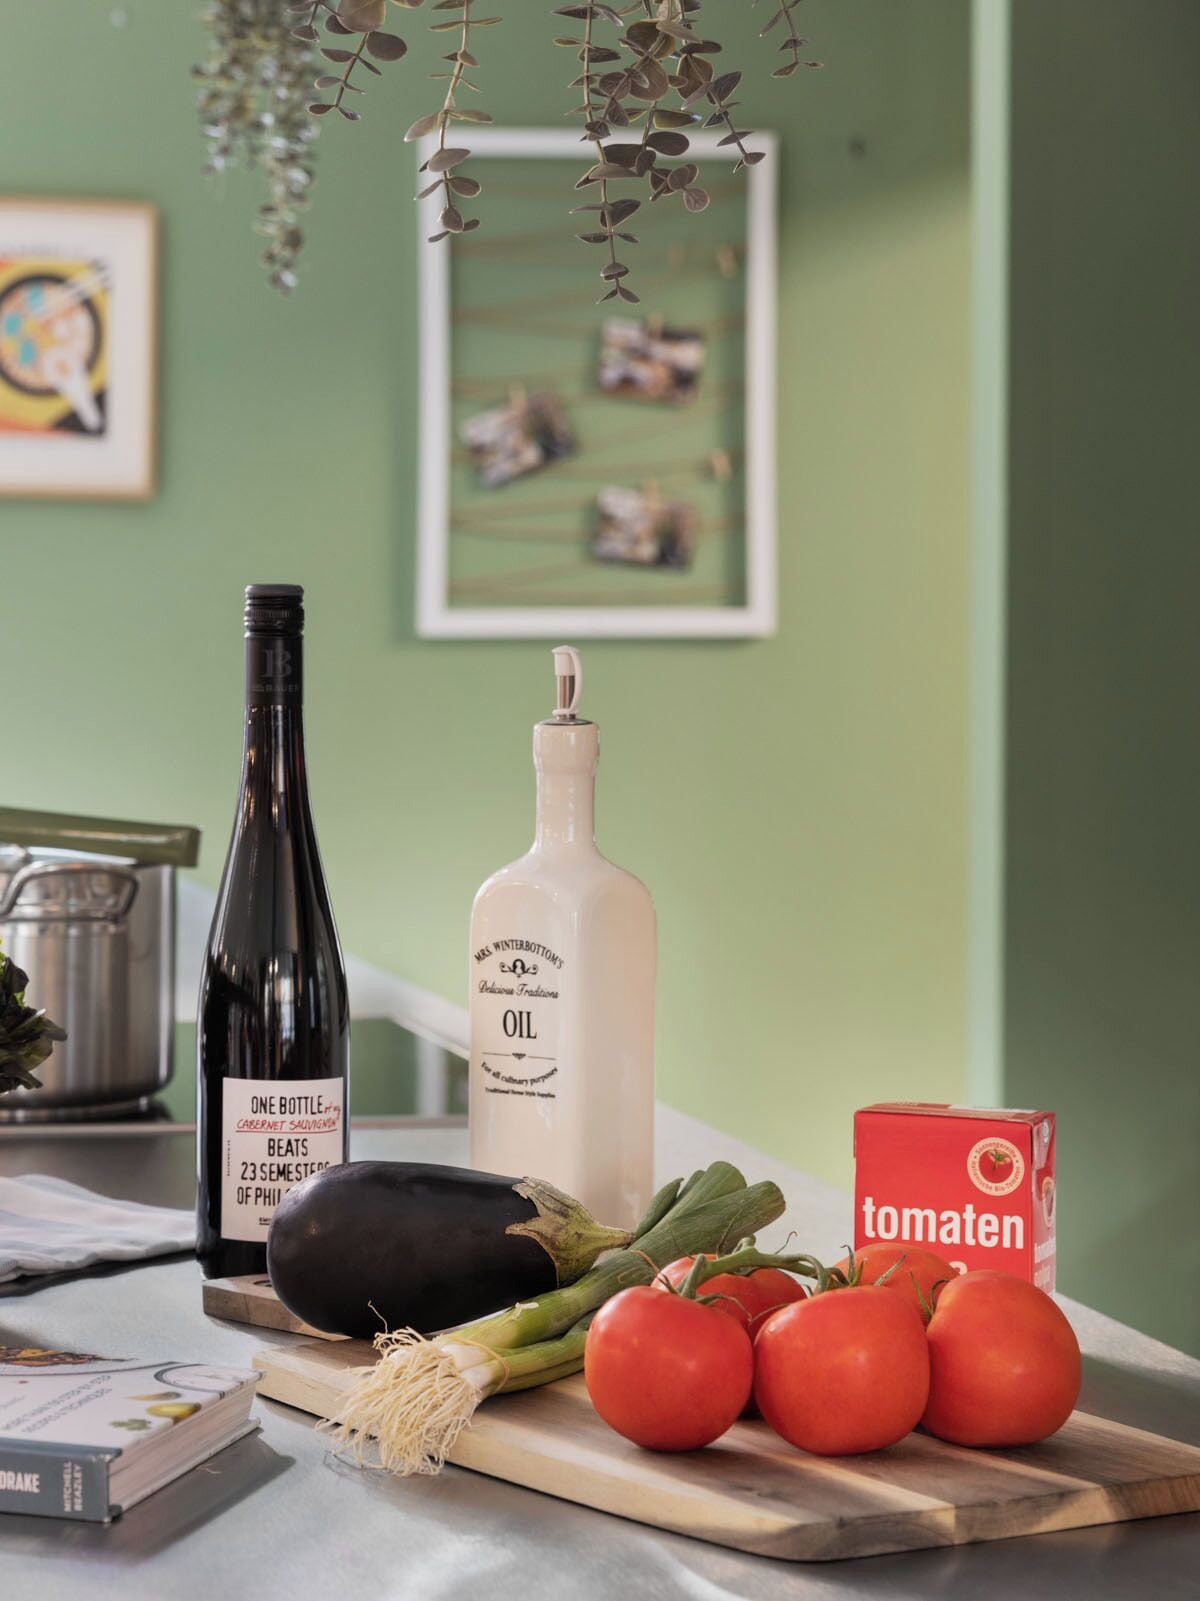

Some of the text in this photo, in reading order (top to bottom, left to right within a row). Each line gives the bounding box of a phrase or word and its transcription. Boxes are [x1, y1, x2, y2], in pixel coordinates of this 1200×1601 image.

[492, 939, 565, 970] WINTERBOTTOM'S
[478, 980, 559, 999] Delicious Traditions
[503, 1009, 537, 1039] OIL
[251, 1096, 276, 1115] ONE
[279, 1095, 324, 1115] BOTTLE
[236, 1117, 337, 1131] CABERNET SAUVIGNON
[267, 1138, 308, 1157] BEATS
[241, 1162, 257, 1181] 23
[237, 1186, 252, 1205] OF
[862, 1197, 1025, 1250] tomaten
[63, 1461, 72, 1512] MITCHELL
[73, 1464, 83, 1512] BEAZLEY
